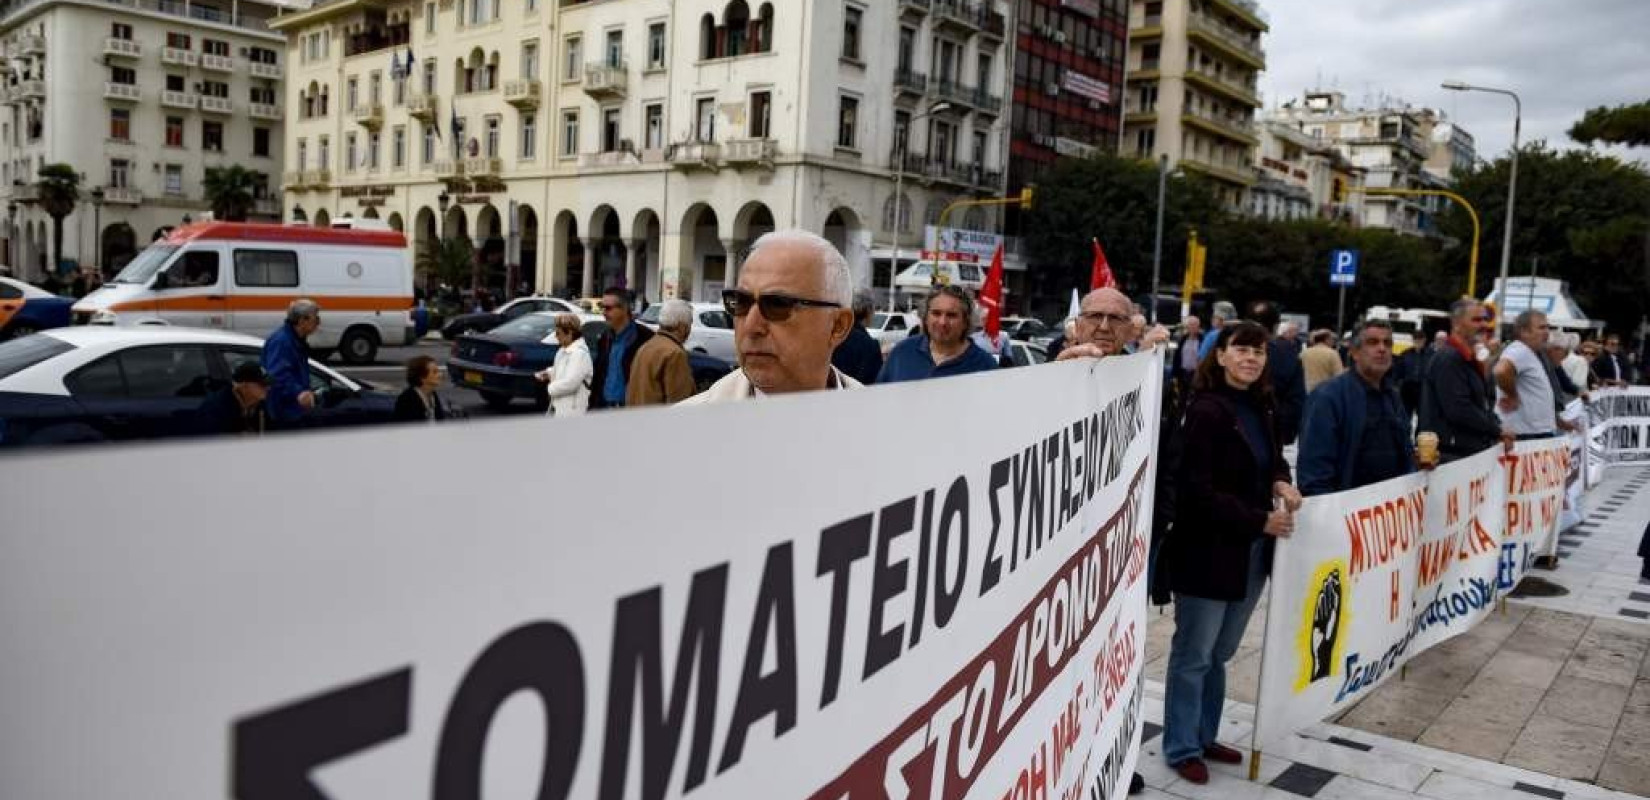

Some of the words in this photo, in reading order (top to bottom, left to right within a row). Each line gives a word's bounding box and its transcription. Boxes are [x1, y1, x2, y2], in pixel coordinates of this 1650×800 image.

[1338, 250, 1353, 273] P
[1390, 570, 1400, 623] Η
[997, 543, 1101, 733] ΔΡΟΜΟ
